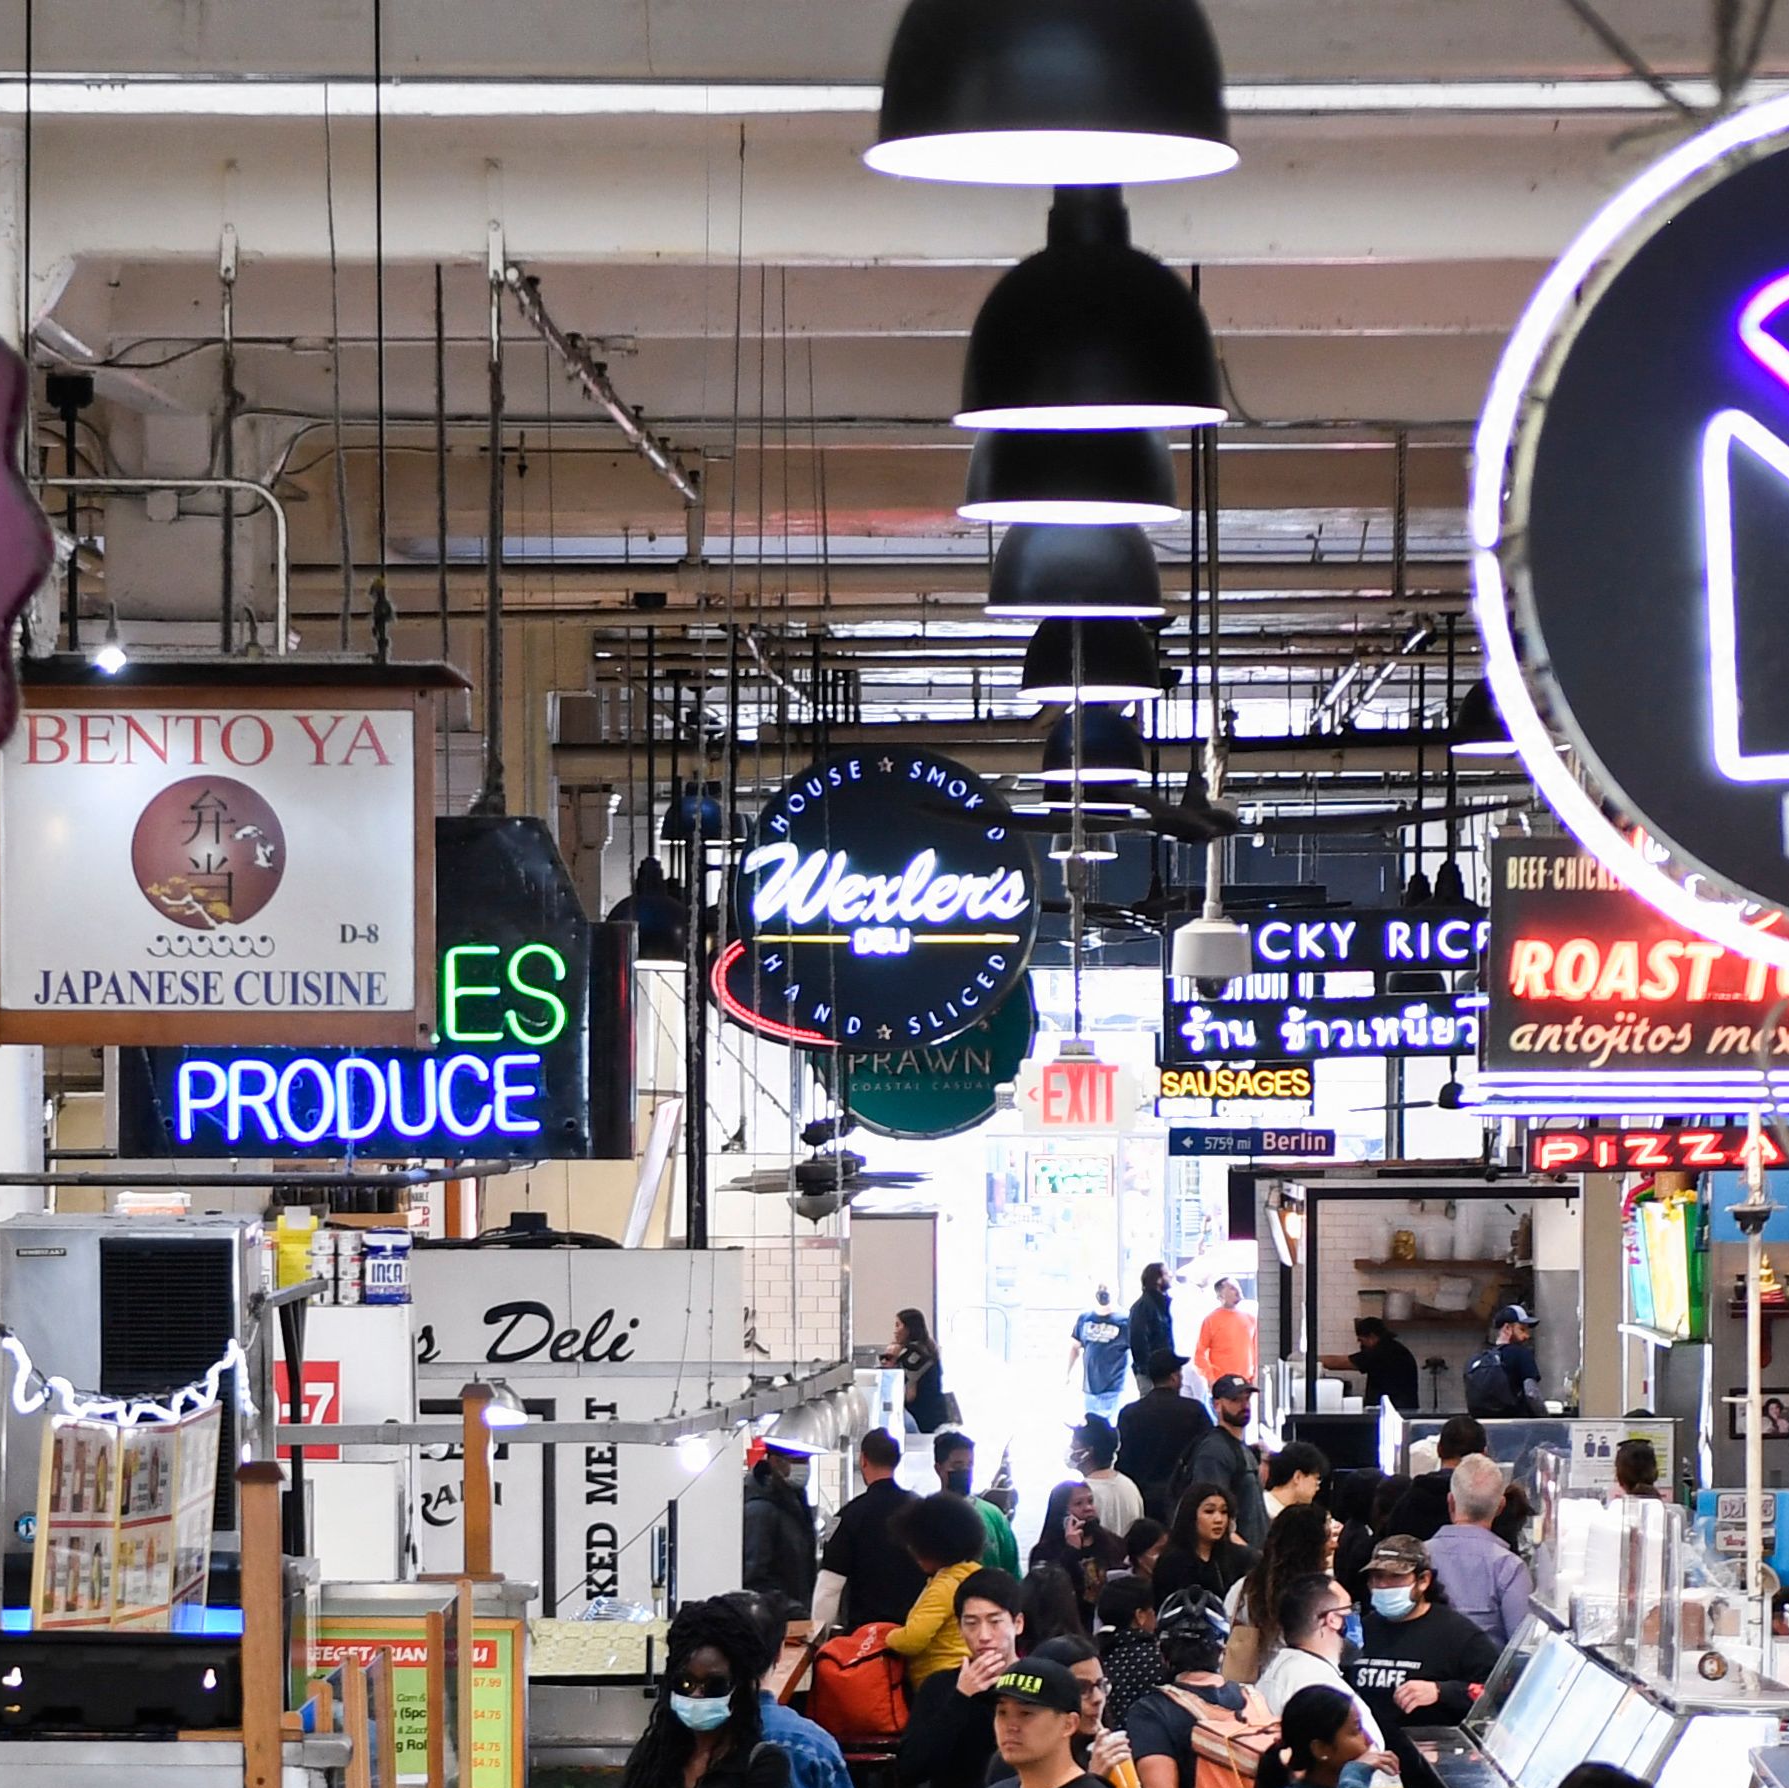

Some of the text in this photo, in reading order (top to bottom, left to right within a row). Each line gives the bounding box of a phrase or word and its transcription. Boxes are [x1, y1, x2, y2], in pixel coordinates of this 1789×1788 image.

[21, 713, 394, 767] BENTO YA
[770, 760, 1006, 841] HOUSE SMOKD
[339, 923, 380, 945] D-8
[853, 927, 911, 955] DELI
[1240, 921, 1356, 961] CKY
[34, 969, 389, 1006] JAPANESE CUISINE
[431, 943, 567, 1046] ES
[763, 953, 1006, 1035] HAND SLICED
[1511, 938, 1724, 1002] ROAST
[849, 1048, 991, 1075] PRAWN
[1509, 1012, 1692, 1068] antojitos
[178, 1054, 541, 1144] PRODUCE
[1043, 1063, 1119, 1124] EXIT
[1162, 1069, 1311, 1098] SAUSAGES
[1262, 1131, 1327, 1152] Berlin
[1536, 1133, 1783, 1169] PIZZA
[483, 1300, 640, 1363] Deli
[585, 1398, 619, 1505] MET
[1357, 1667, 1407, 1688] STAFF
